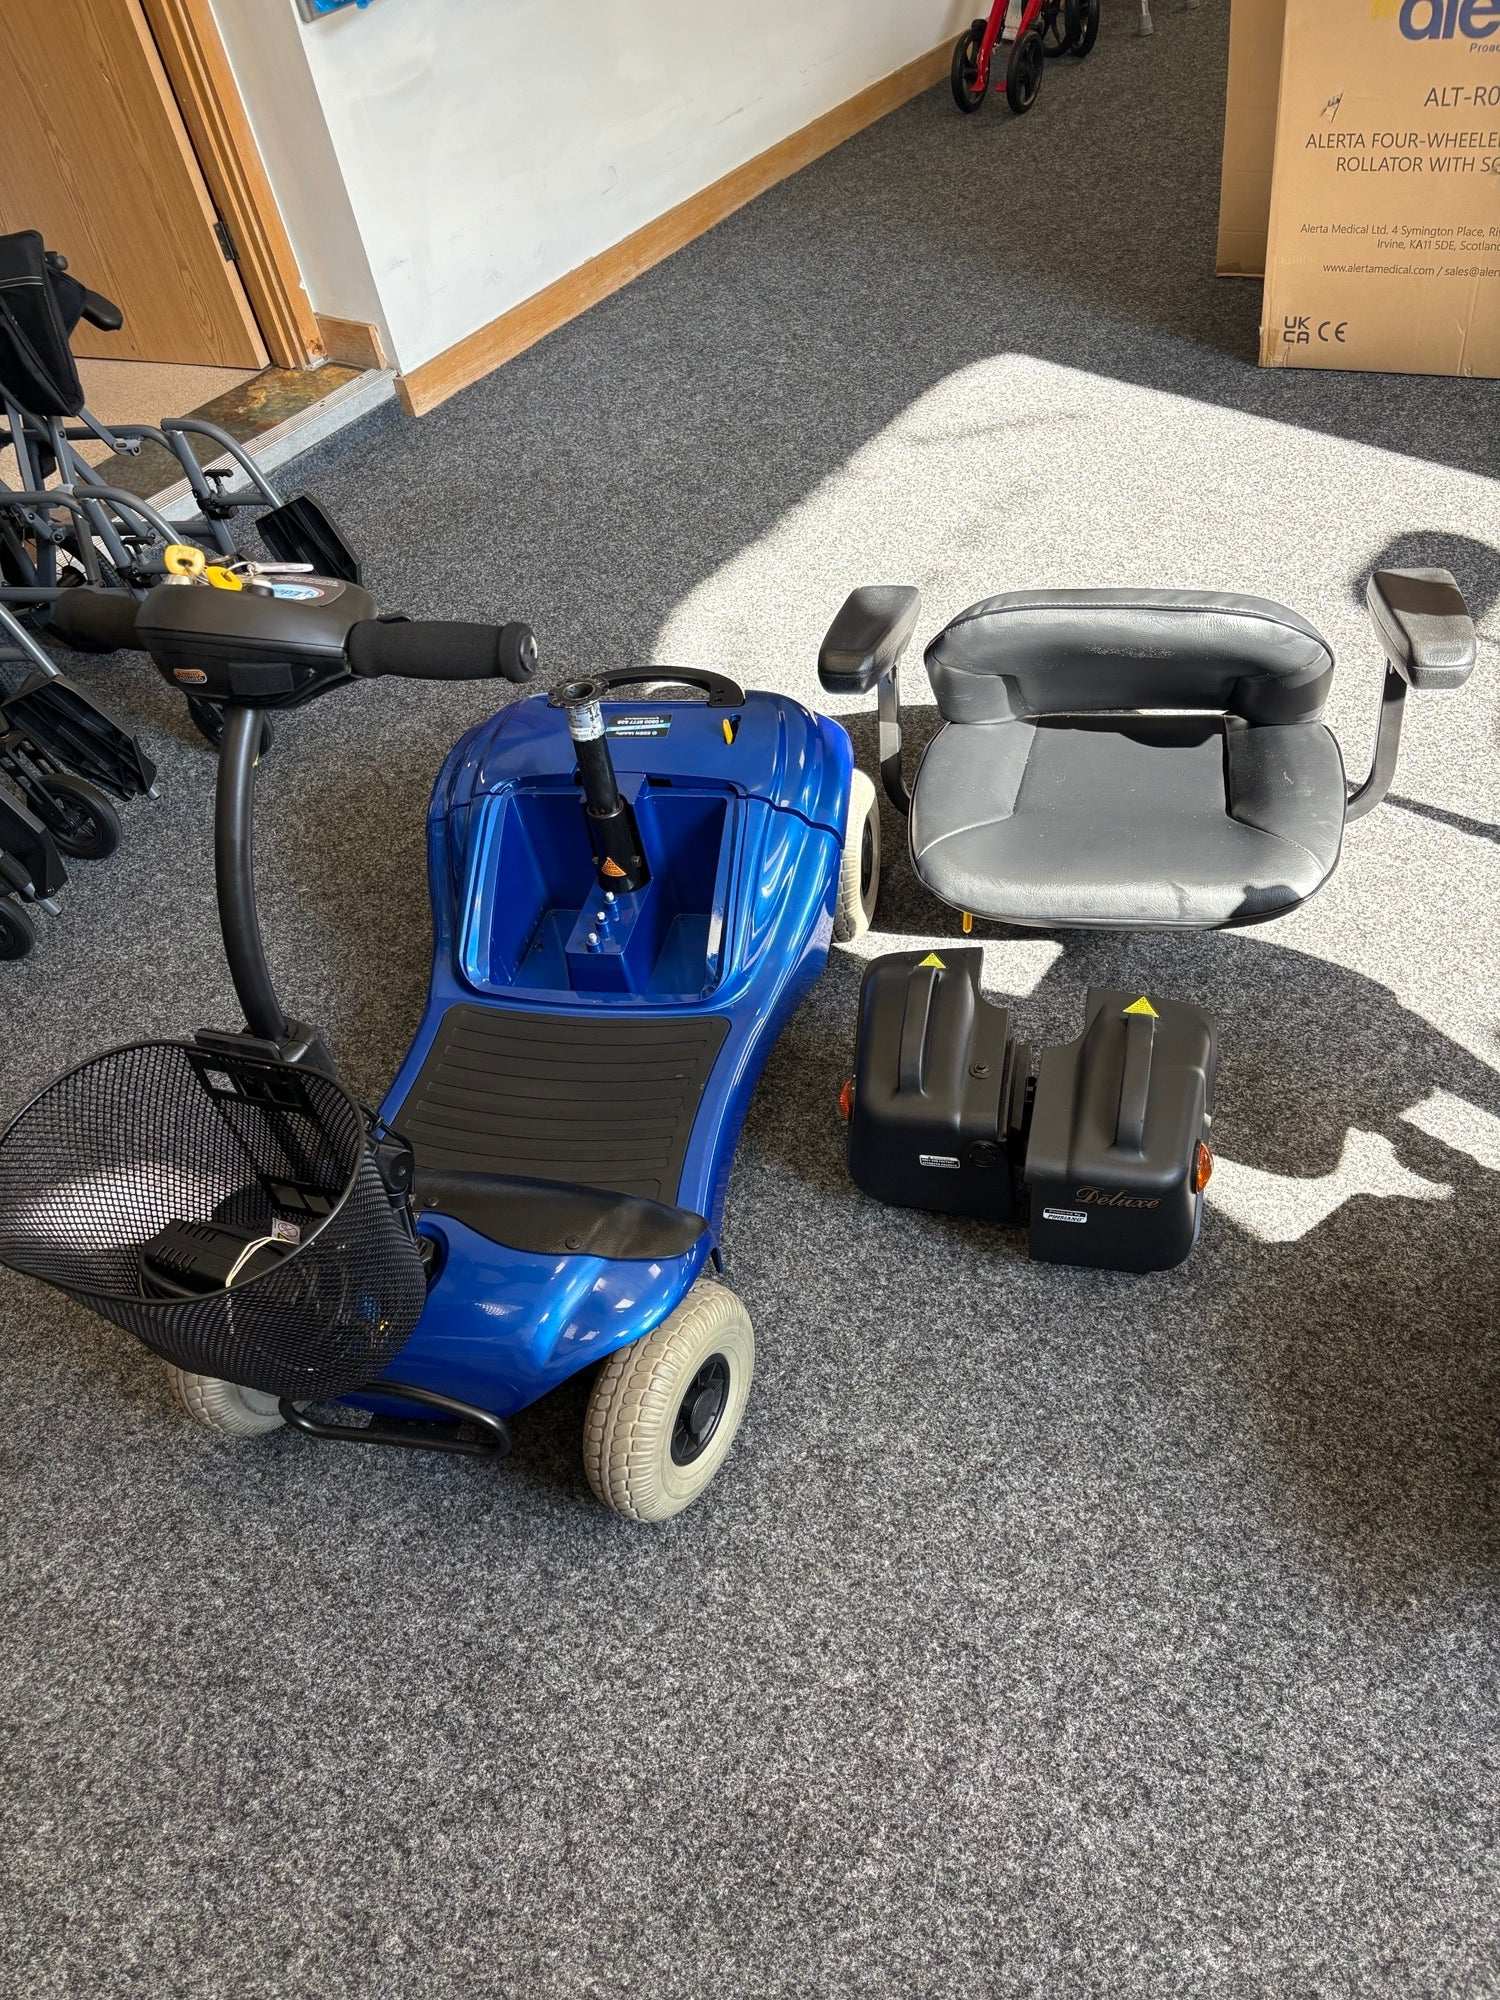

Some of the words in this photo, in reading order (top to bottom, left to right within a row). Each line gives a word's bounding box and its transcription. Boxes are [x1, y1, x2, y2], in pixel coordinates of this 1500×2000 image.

[1305, 133, 1366, 149] ALERTA
[1371, 132, 1500, 149] FOUR-WHEELE
[1336, 156, 1423, 173] ROLLATOR
[1429, 156, 1475, 173] WITH
[1300, 224, 1329, 234] Alerta
[1331, 224, 1368, 235] Medical
[1371, 224, 1389, 235] Ltd.
[1391, 225, 1398, 235] 4
[1401, 225, 1454, 238] Symington
[1456, 226, 1485, 238] Place,
[1488, 227, 1500, 237] Ri
[1377, 239, 1405, 250] Irvine,
[1409, 239, 1432, 249] KA11
[1435, 240, 1456, 252] 5DE,
[1322, 264, 1435, 275] www.alertamedical.com
[1444, 266, 1500, 278] sales@aler
[1284, 316, 1311, 329] UK
[1283, 331, 1309, 344] CA
[1318, 321, 1348, 342] CE
[1074, 1185, 1161, 1209] Deluxe
